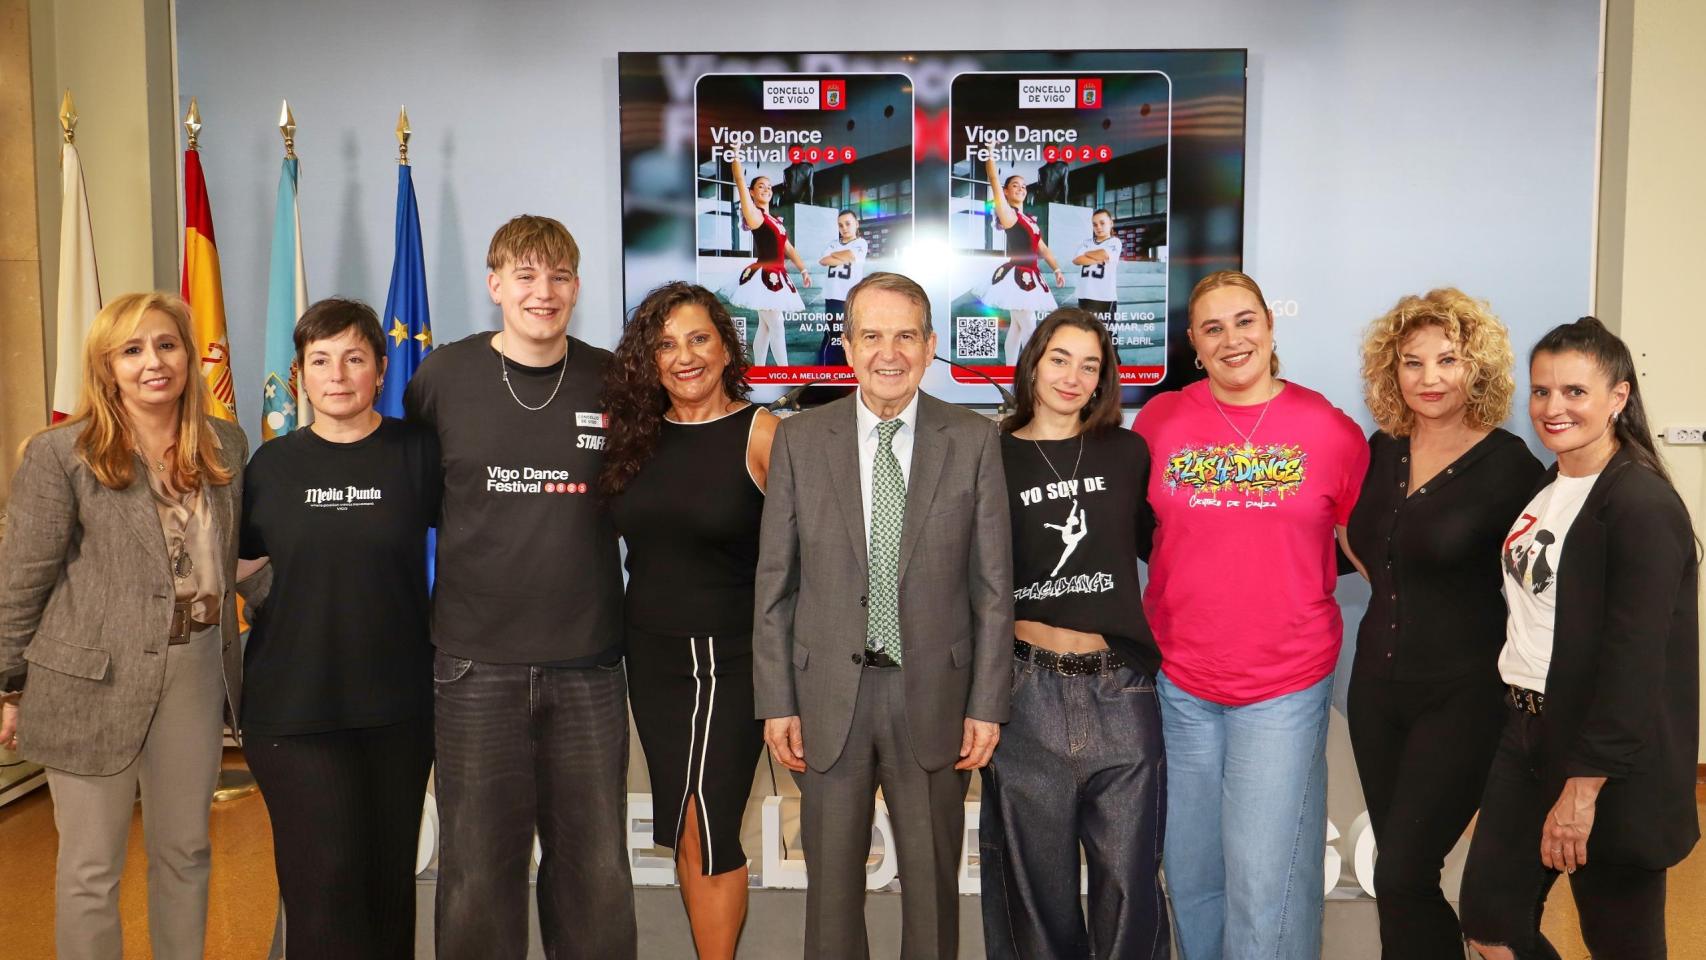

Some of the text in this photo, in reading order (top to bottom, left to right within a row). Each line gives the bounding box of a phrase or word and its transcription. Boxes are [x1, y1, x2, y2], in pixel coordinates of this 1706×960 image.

[767, 87, 815, 95] CONCELLO
[1023, 85, 1071, 94] CONCELLO
[773, 96, 810, 104] DE VIGO
[1028, 94, 1065, 103] DE VIGO
[710, 127, 822, 147] Vigo Dance
[965, 125, 1077, 147] Vigo Dance
[711, 146, 853, 163] Festival 2026
[966, 144, 1109, 162] Festival 2026
[778, 312, 833, 321] AUDITORIO
[1114, 312, 1128, 320] DE
[1130, 312, 1155, 320] VIGO
[799, 323, 813, 332] AV.
[816, 323, 830, 332] DA
[1103, 323, 1141, 332] RAMAR,
[831, 337, 842, 346] 25
[1112, 337, 1154, 345] DE ABRIL
[487, 466, 569, 481] Vigo Dance
[487, 480, 541, 493] Festival
[1020, 476, 1107, 506] YO SOY DE
[304, 485, 382, 503] Media Punta
